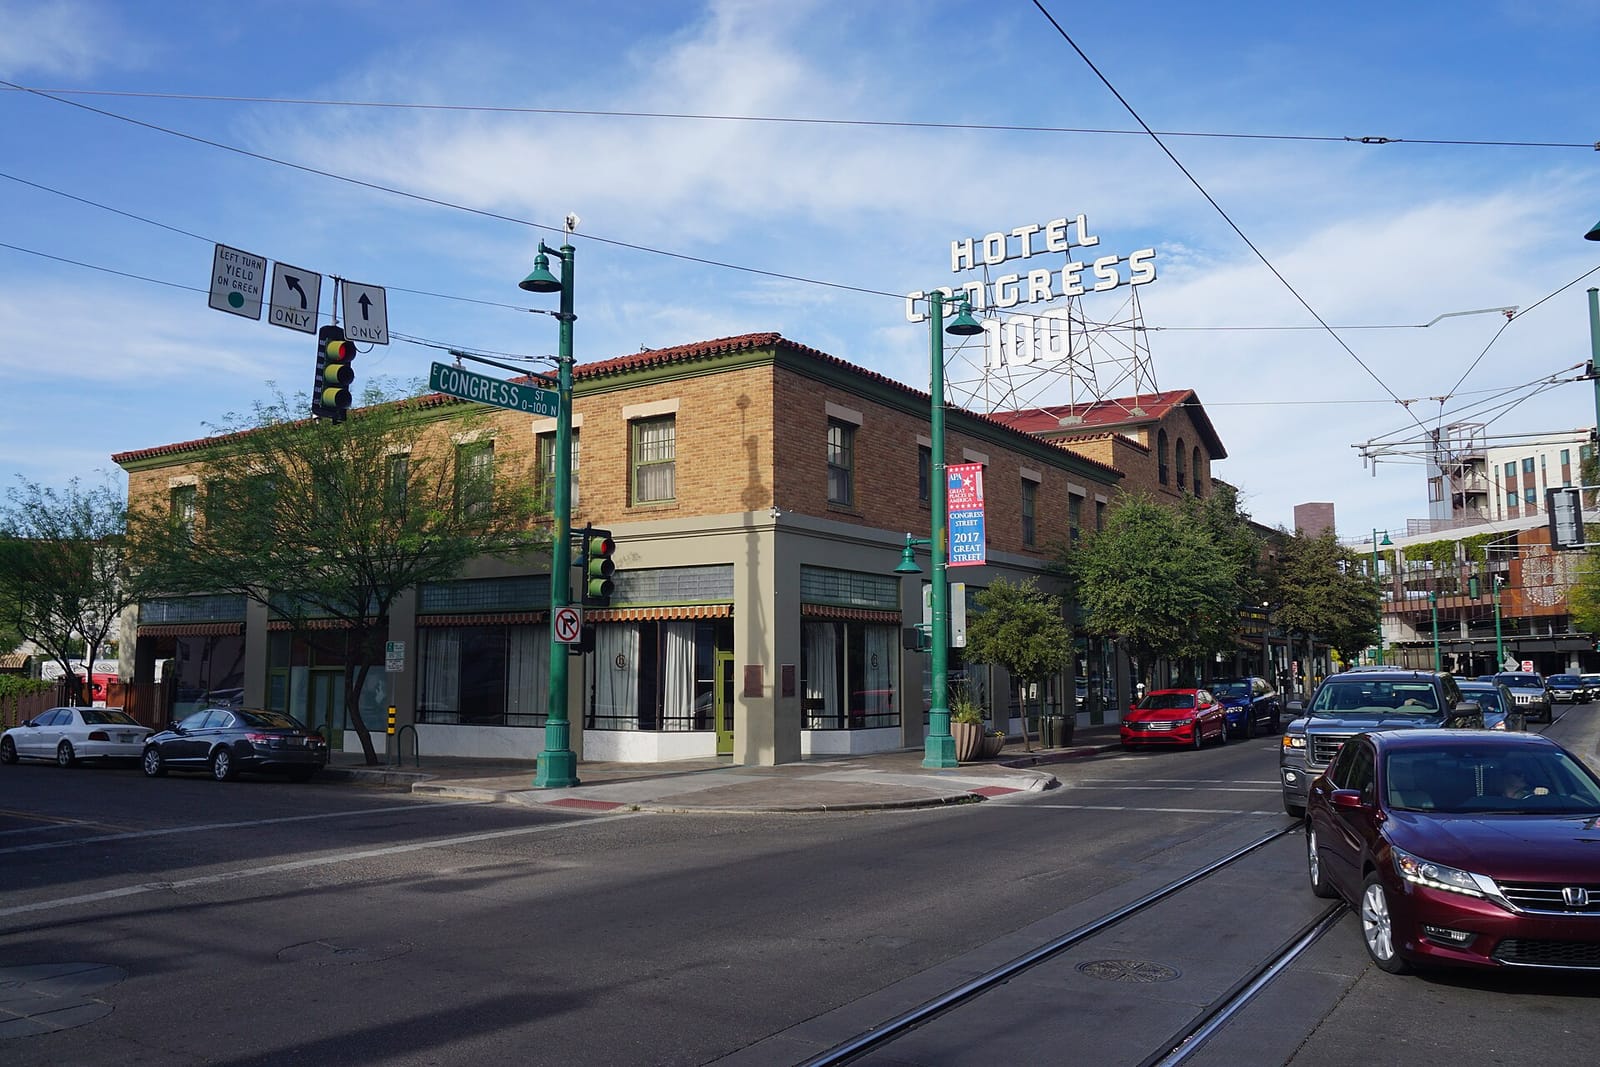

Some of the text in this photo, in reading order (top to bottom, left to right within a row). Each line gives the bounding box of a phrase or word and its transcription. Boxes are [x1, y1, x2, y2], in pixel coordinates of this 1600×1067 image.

[951, 214, 1099, 272] HOTEL
[219, 250, 262, 271] LEFT TURN
[226, 263, 254, 281] YIELD
[217, 276, 259, 295] ON GREEN
[275, 309, 310, 328] ONLY
[351, 325, 382, 340] ONLY
[982, 306, 1071, 370] 100
[432, 364, 545, 407] E CONGRESS ST
[521, 400, 557, 416] 0-100 N
[950, 511, 984, 519] CONGRESS
[955, 519, 978, 527] STREET
[954, 532, 980, 543] 2017
[953, 544, 981, 553] GREAT
[953, 553, 982, 562] STREET
